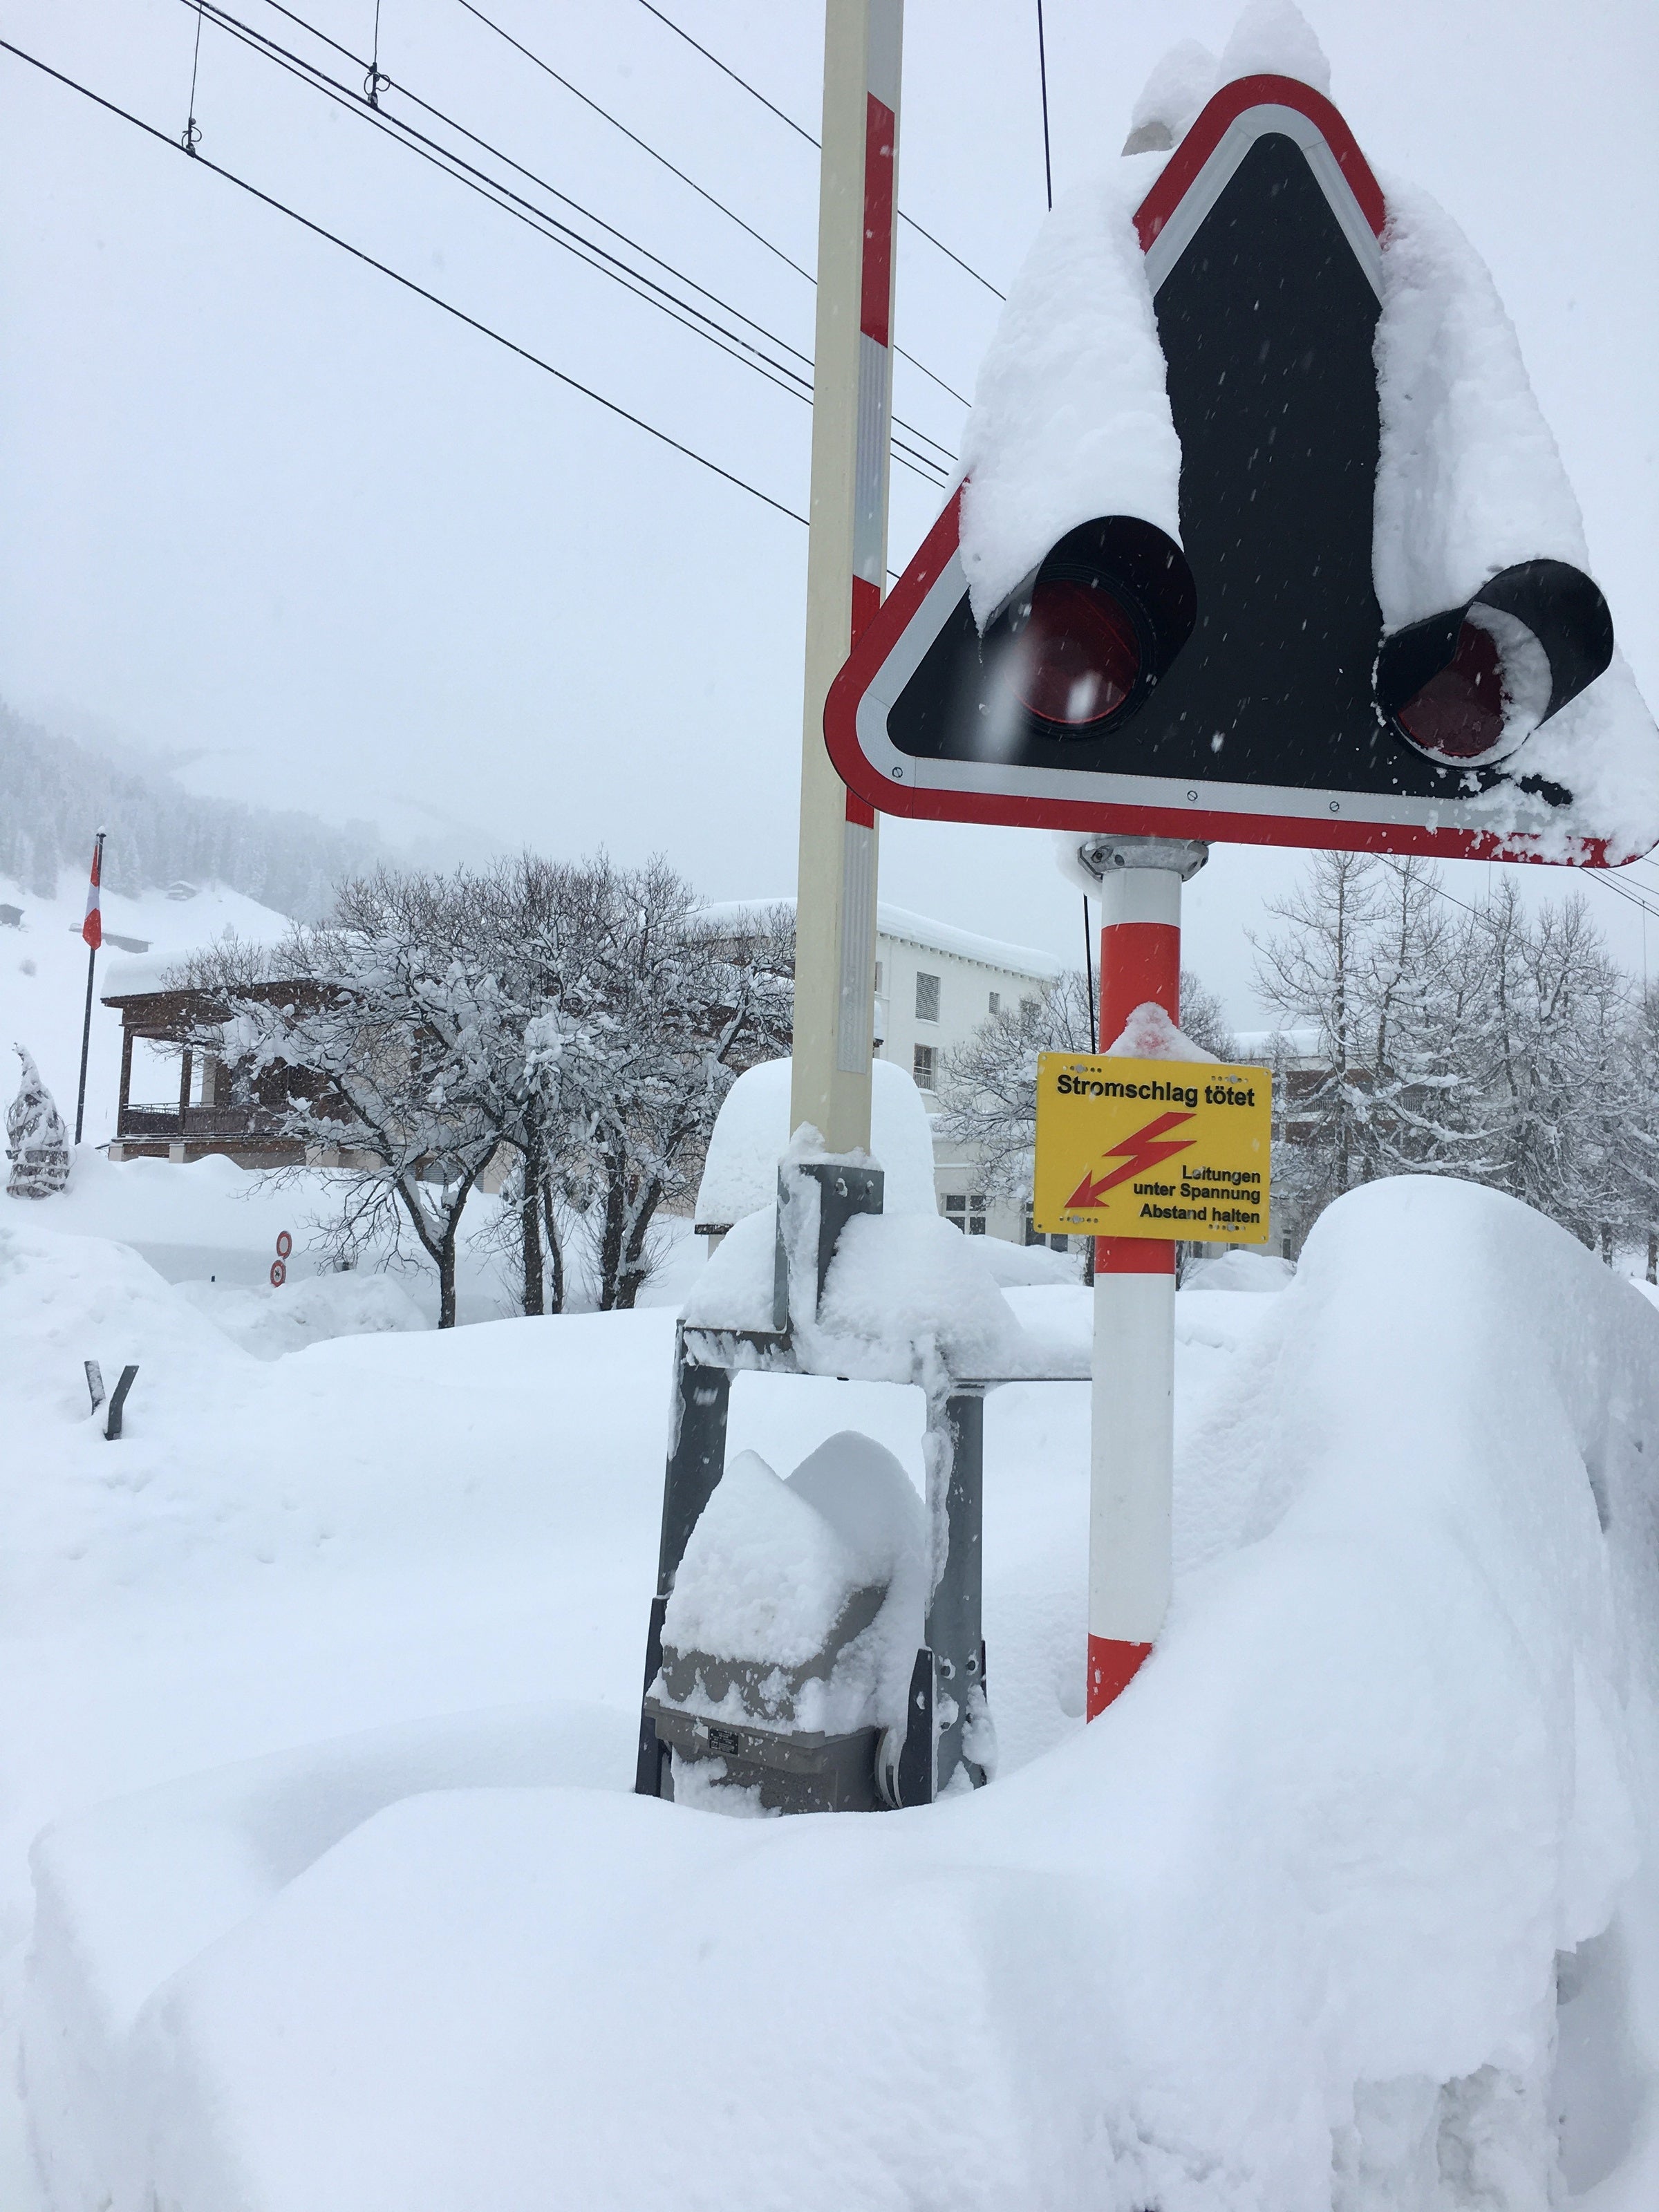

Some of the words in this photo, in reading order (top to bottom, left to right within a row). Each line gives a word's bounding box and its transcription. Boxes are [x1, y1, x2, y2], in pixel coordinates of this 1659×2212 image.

[1058, 1075, 1197, 1107] Stromschlag
[1205, 1085, 1255, 1107] tötet
[1183, 1165, 1260, 1185] Leitungen
[1134, 1182, 1176, 1196] unter
[1180, 1183, 1260, 1204] Spannung
[1140, 1203, 1206, 1220] Abstand
[1212, 1208, 1259, 1223] halten
